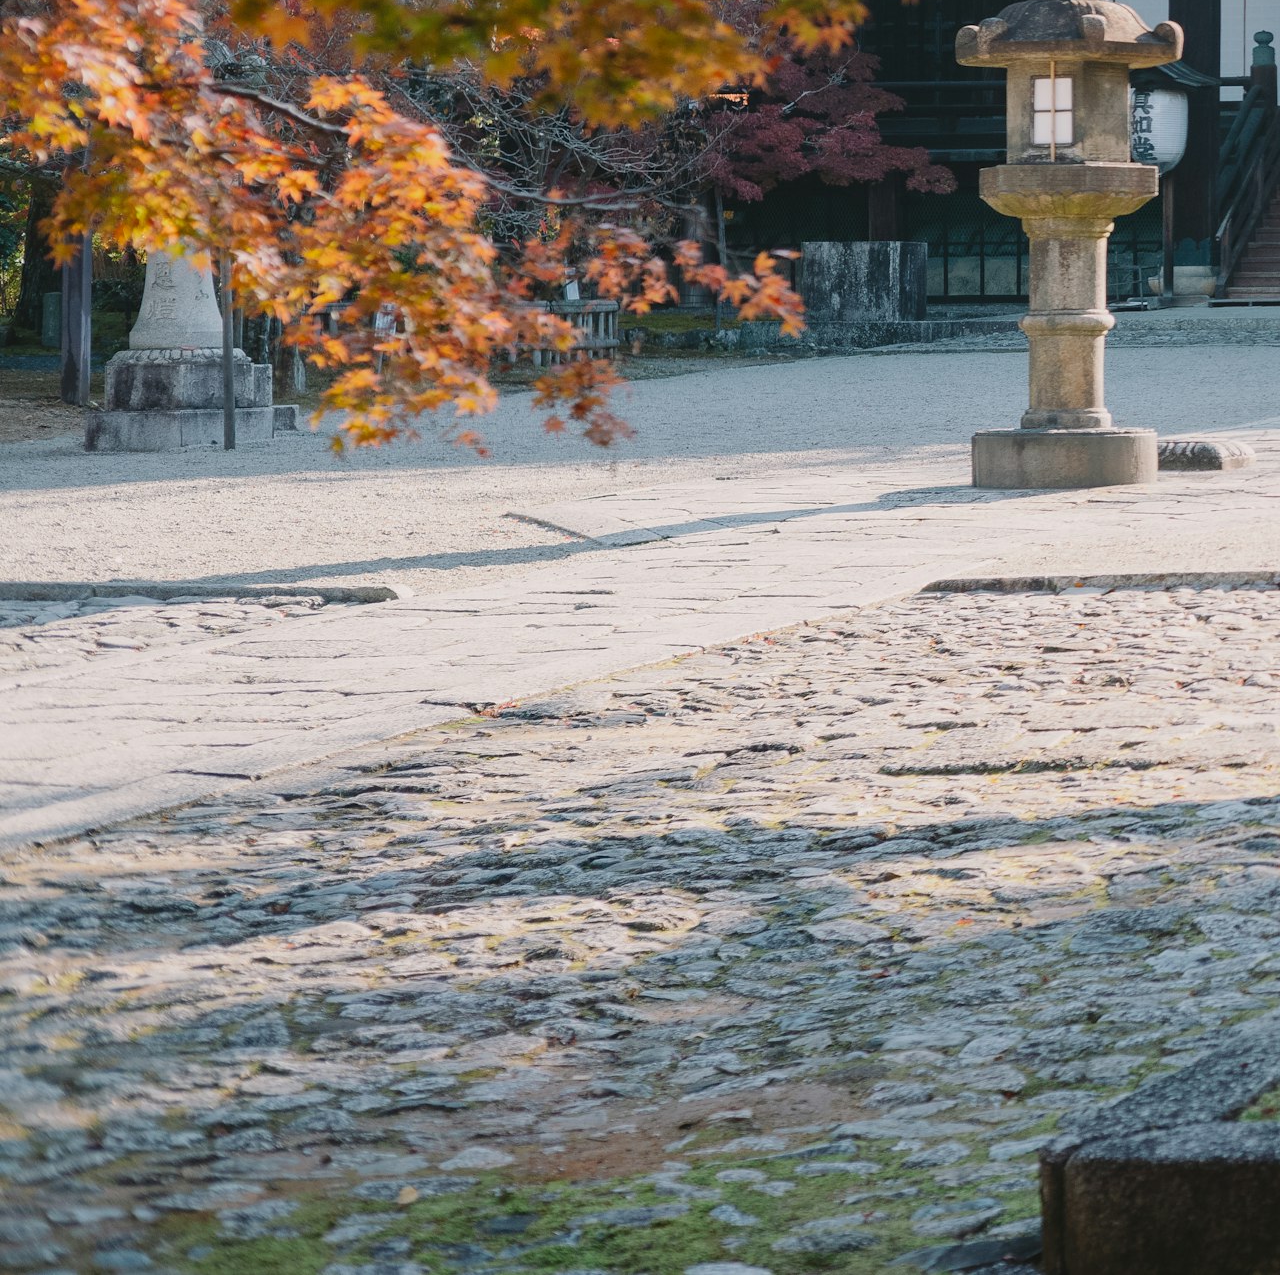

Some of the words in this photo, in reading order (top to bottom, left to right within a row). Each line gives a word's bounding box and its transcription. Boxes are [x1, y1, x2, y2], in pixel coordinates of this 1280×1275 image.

[1131, 90, 1157, 161] 真如堂
[147, 261, 178, 321] 恩燈
